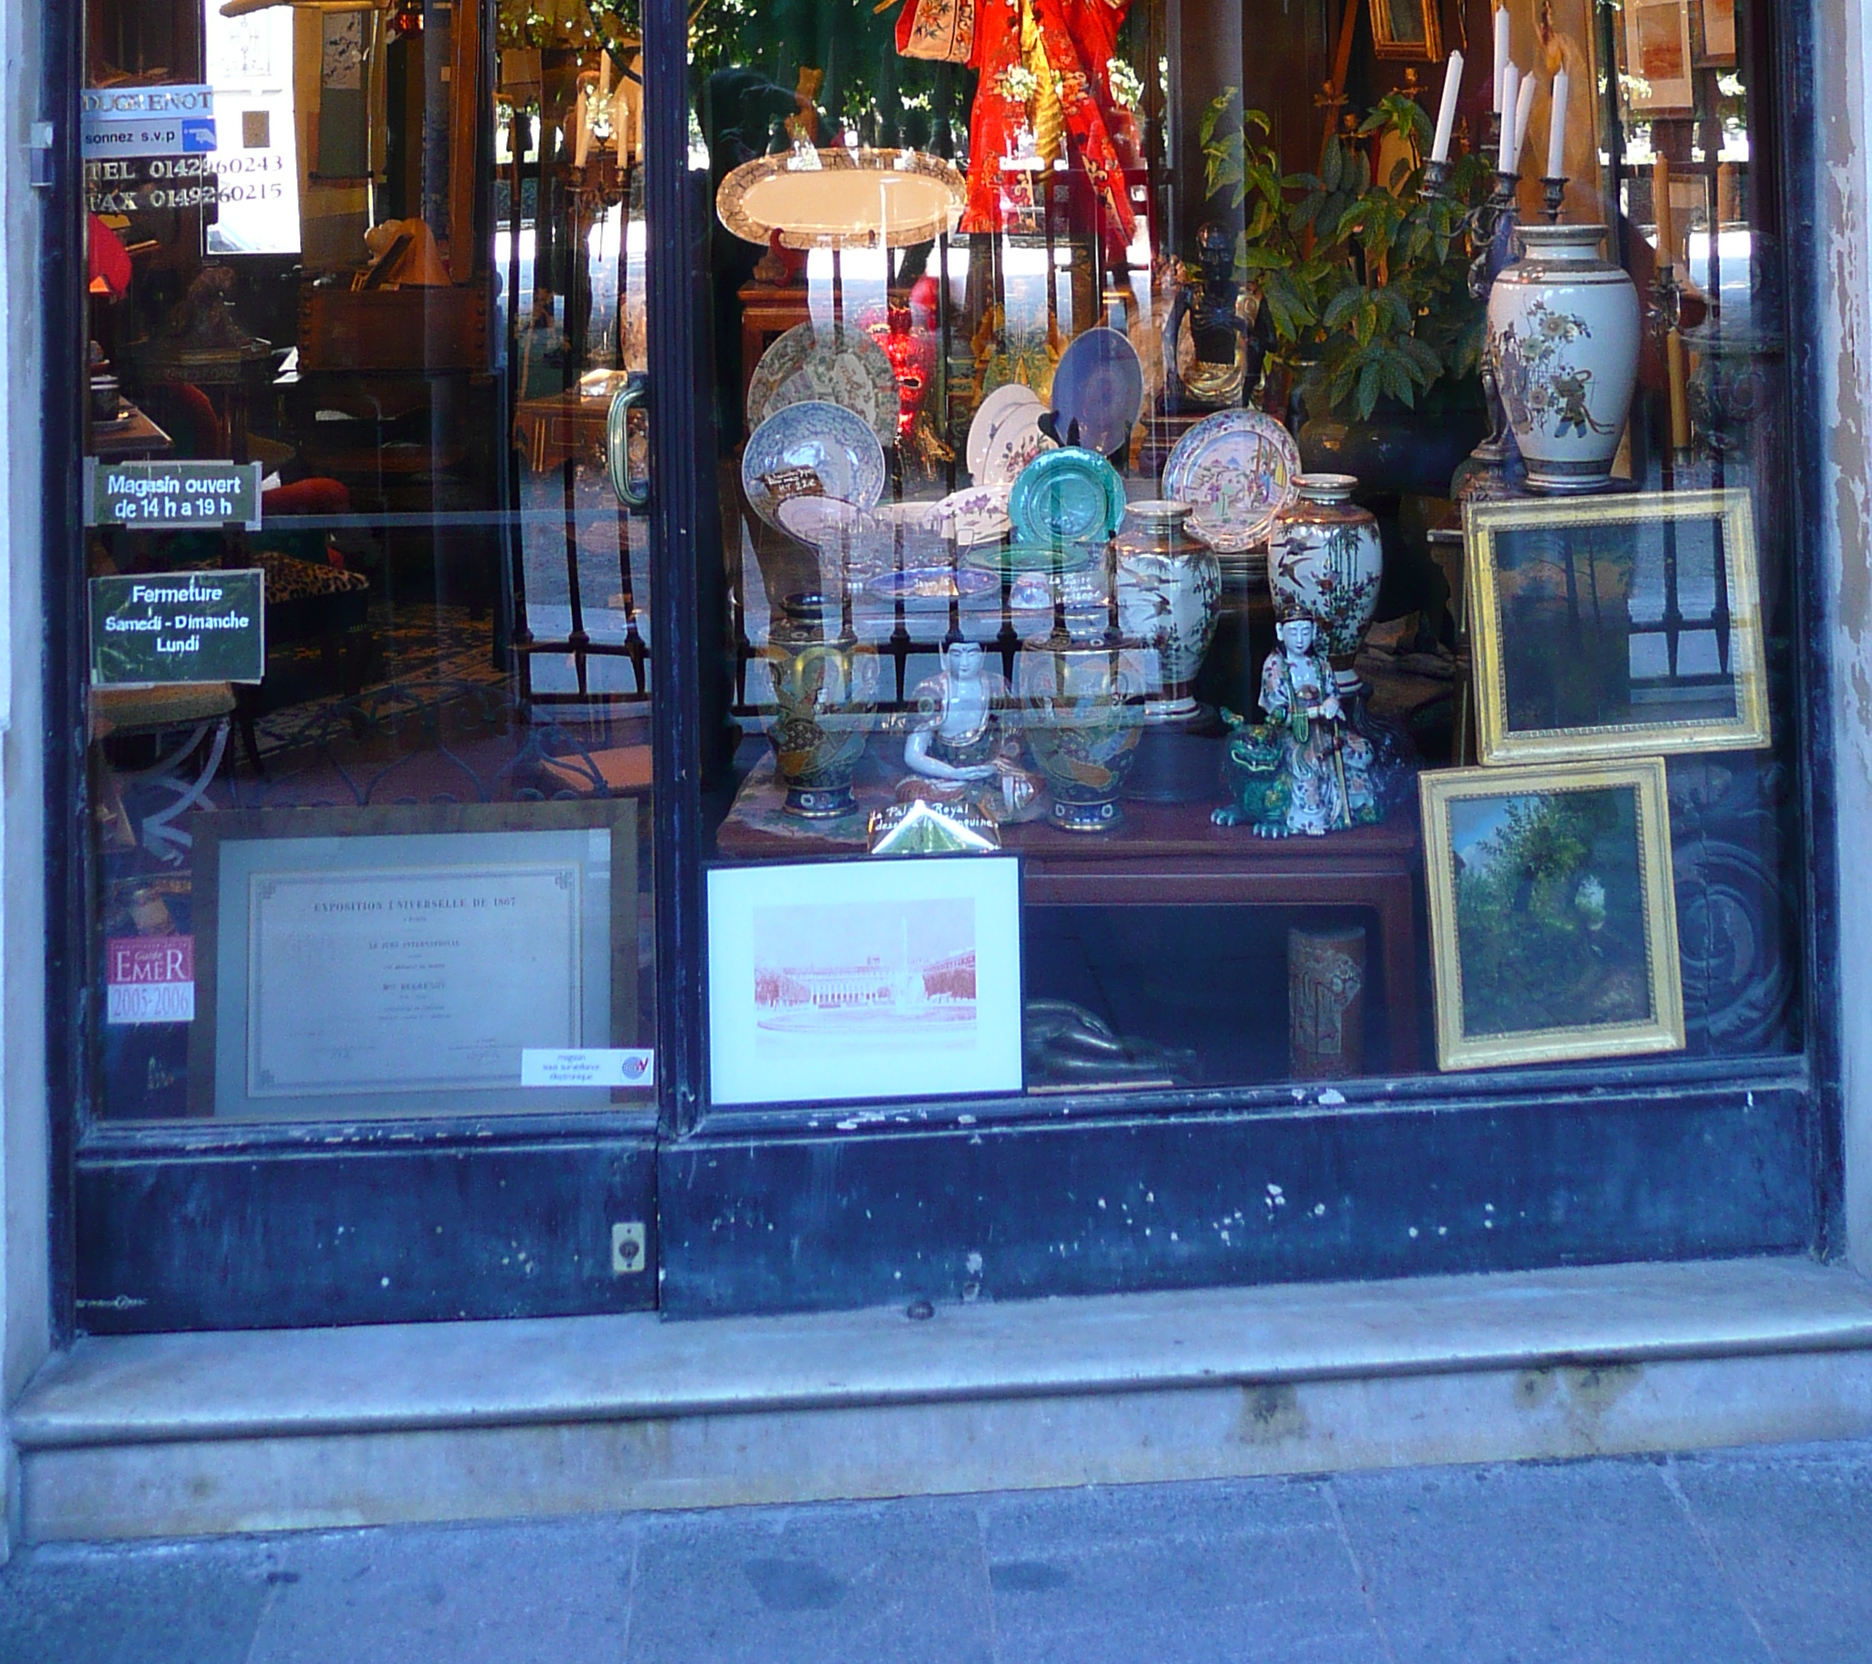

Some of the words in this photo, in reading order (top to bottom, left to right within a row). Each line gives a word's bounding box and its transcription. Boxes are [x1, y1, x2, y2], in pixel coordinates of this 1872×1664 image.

[83, 91, 213, 112] DUGRENOT
[85, 132, 134, 145] sonnez
[84, 162, 136, 180] TEL
[149, 155, 283, 179] 0142960243
[87, 191, 138, 212] FAX
[149, 183, 283, 208] 0149260215
[107, 474, 180, 497] Magasin
[185, 475, 241, 493] ouvert
[115, 499, 136, 518] de
[140, 499, 159, 517] 14
[164, 496, 177, 517] h
[195, 498, 215, 515] 19
[220, 497, 232, 515] h
[132, 585, 223, 603] Fermeture
[105, 615, 162, 631] Samedi
[174, 610, 249, 628] Dimanche
[156, 635, 200, 653] Lundi
[932, 802, 968, 818] Royal
[314, 901, 383, 912] EXPOSITION
[388, 899, 466, 910] UNIVERSELLE
[473, 898, 487, 907] DE
[112, 986, 189, 1017] 2005-2006
